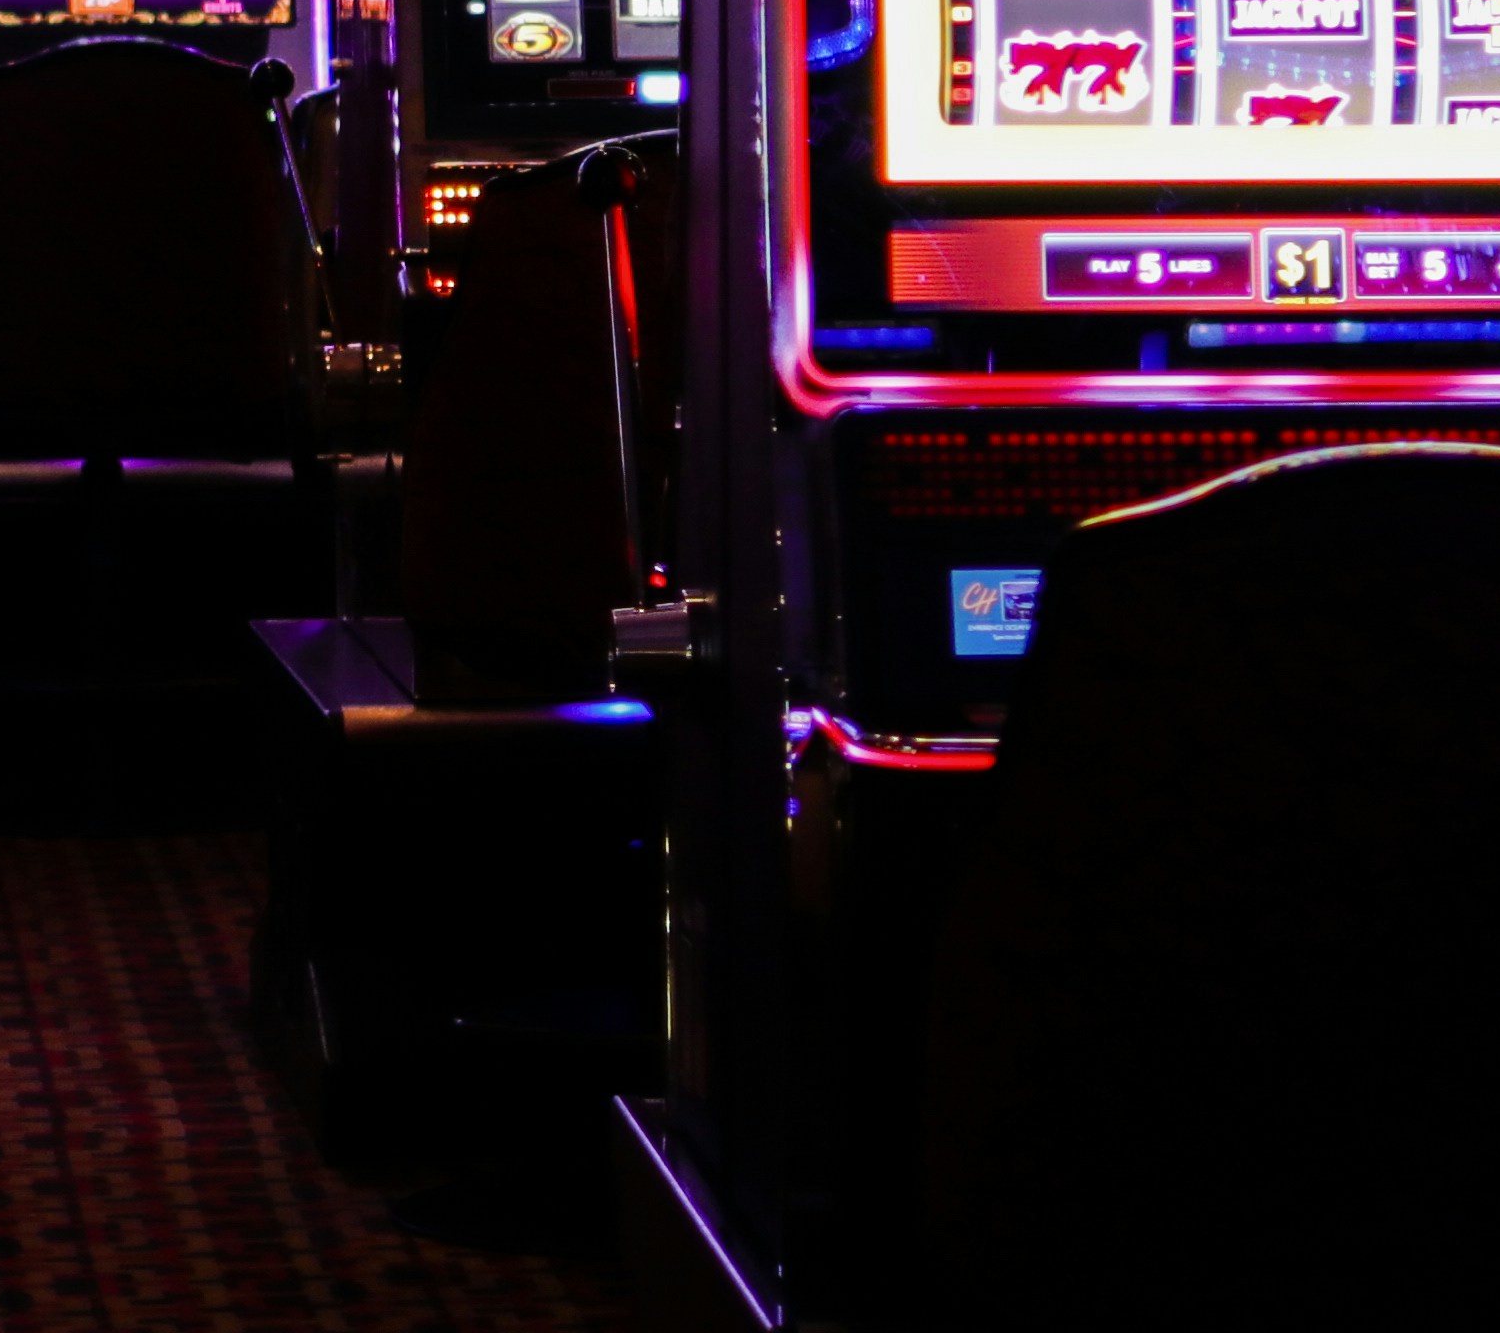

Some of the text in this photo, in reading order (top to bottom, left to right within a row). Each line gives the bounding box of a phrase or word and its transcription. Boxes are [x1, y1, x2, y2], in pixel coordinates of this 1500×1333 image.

[512, 24, 555, 53] 5
[1089, 252, 1212, 284] PLAY 5 LINES
[1276, 238, 1333, 290] $1
[1368, 265, 1397, 279] BET
[1423, 250, 1447, 281] 5
